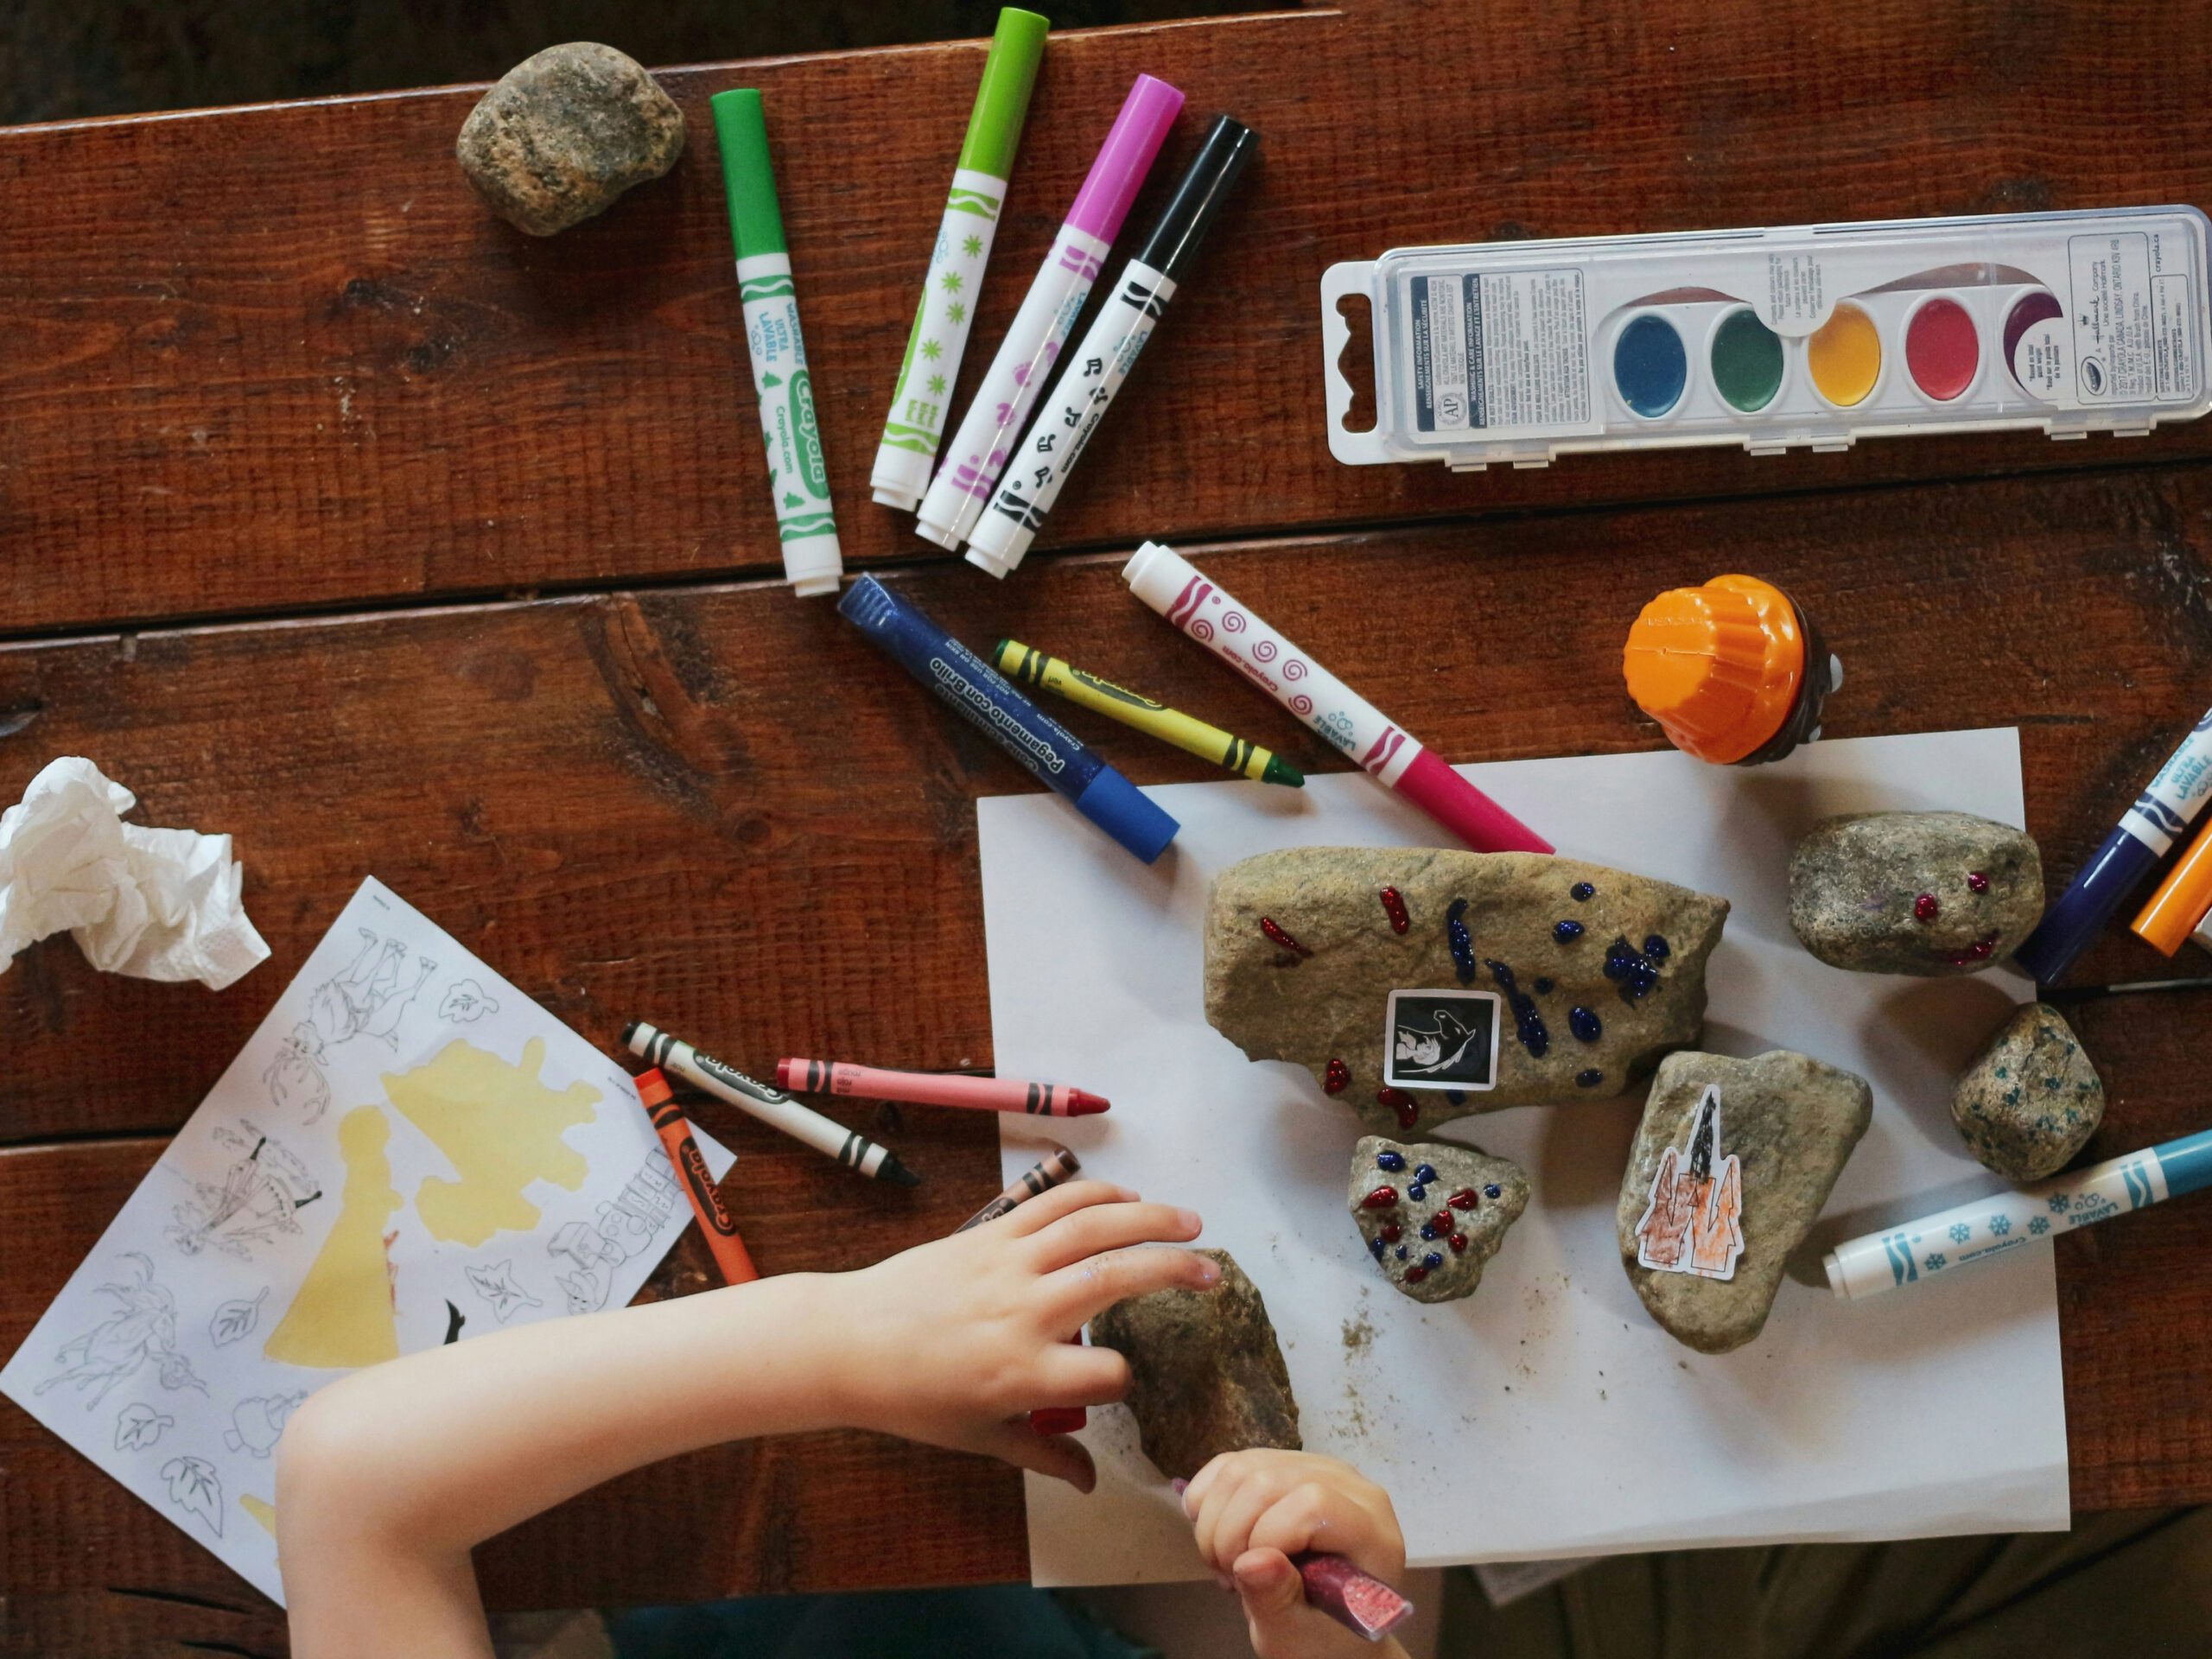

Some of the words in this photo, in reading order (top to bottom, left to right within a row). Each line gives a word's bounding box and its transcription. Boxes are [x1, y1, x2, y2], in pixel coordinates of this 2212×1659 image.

[2151, 233, 2161, 272] crayola.ca
[2090, 260, 2101, 291] Company
[2112, 264, 2122, 289] ONTARIO
[757, 311, 779, 362] LAVABLE
[773, 318, 790, 351] ULTRA
[785, 302, 806, 365] WASHABLE
[1422, 330, 1428, 339] LA
[1465, 302, 1474, 346] INFORMATION
[2088, 295, 2105, 345] Hallmark
[2116, 346, 2126, 373] CRAYOLA
[1423, 353, 1433, 409] RENSEIGNEMENTS
[1476, 370, 1485, 425] RENSEIGNEMENTS
[2118, 374, 2127, 389] 2017
[1442, 397, 1458, 416] AP
[775, 405, 796, 474] Crayola.com
[793, 378, 825, 484] Crayola
[1059, 410, 1101, 474] Crayola.com
[944, 640, 960, 656] SKIN
[968, 661, 983, 674] USE
[1221, 644, 1279, 692] Crayola.com
[924, 654, 969, 696] Brillo
[995, 682, 1010, 696] NOT
[961, 683, 994, 714] con
[984, 704, 1065, 772] Pegamento
[1033, 711, 1081, 752] Crayola.com
[1312, 713, 1357, 752] LAVABLE
[2149, 731, 2195, 793] WASHABLE
[2169, 752, 2196, 785] ULTRA
[2171, 749, 2212, 802] LAVABLE
[684, 1146, 734, 1234] Crayola
[2067, 1200, 2119, 1226] LAVABLE
[1957, 1235, 2026, 1263] Crayola.com
